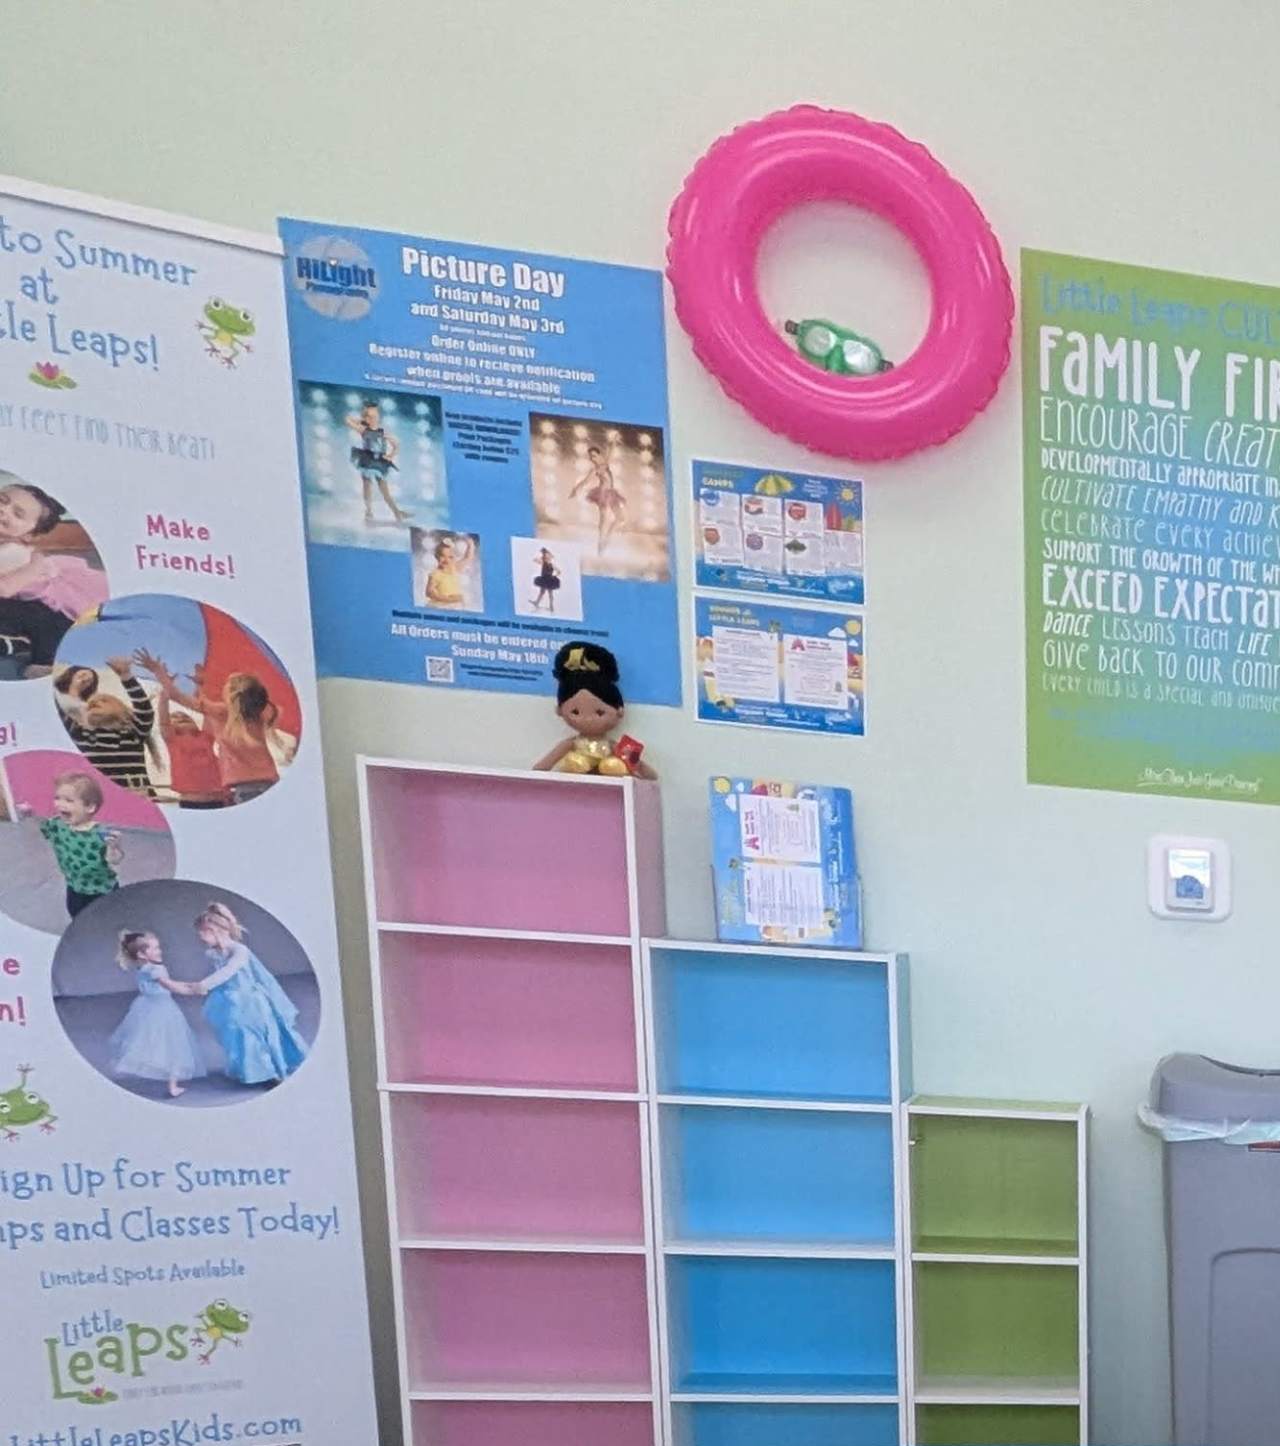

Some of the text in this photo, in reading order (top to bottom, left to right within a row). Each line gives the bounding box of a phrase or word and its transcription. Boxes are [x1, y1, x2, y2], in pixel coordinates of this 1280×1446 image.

[55, 229, 197, 286] Summer
[402, 247, 566, 298] Picture Day
[20, 267, 58, 304] at
[434, 284, 540, 312] Friday May 2nd
[411, 303, 439, 318] and
[441, 305, 506, 328] Saturday
[508, 312, 539, 332] May
[541, 318, 565, 335] 3rd
[47, 312, 159, 371] Leaps!
[431, 335, 535, 359] Order Online ONLY
[369, 343, 421, 361] Register
[423, 350, 462, 367] online
[526, 364, 595, 383] notification
[407, 364, 441, 380] when
[1040, 325, 1200, 411] FAMILY
[1041, 448, 1172, 484] DEVELOPMENTALLY
[1177, 467, 1260, 497] APPROPRIATE
[1143, 488, 1224, 521] EMPATHY
[146, 513, 211, 543] Make
[134, 544, 236, 580] Friends!
[1042, 538, 1102, 563] SUPPORT
[1109, 545, 1137, 568] THE
[1142, 549, 1203, 576] GROWTH
[1207, 556, 1224, 578] OF
[1230, 558, 1258, 583] THE
[1042, 563, 1143, 614] EXCEED
[408, 626, 449, 641] Orders
[451, 631, 482, 644] must
[501, 635, 547, 650] entered
[451, 645, 496, 662] Sunday
[498, 649, 523, 664] May
[1236, 632, 1273, 657] LIFE
[1155, 651, 1179, 680] TO
[1186, 656, 1223, 684] OUR
[0, 1158, 291, 1200] ign Up for Summer
[54, 1202, 340, 1242] and Classes Today!
[40, 1259, 246, 1289] Limited Spots Available
[61, 1309, 123, 1346] Little
[44, 1321, 189, 1399] Leaps
